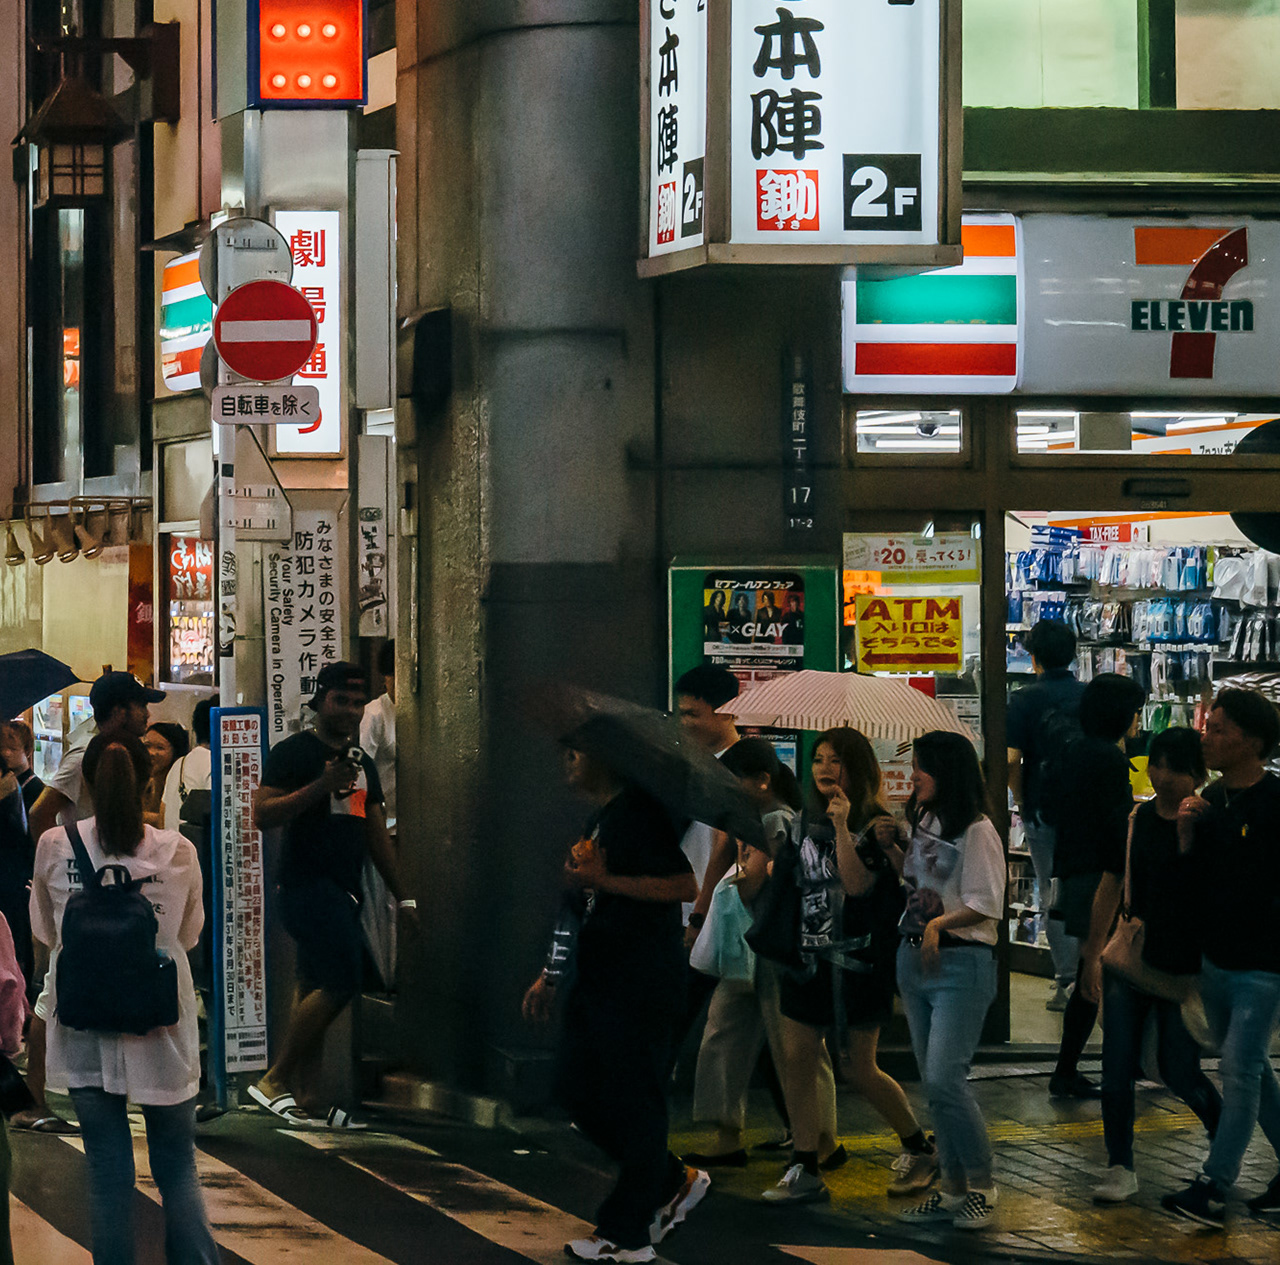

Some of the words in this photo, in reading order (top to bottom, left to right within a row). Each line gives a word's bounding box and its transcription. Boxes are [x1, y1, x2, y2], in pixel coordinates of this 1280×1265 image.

[683, 171, 703, 223] 2F
[850, 165, 919, 217] 2F
[219, 391, 312, 419] 自転車を除く
[791, 486, 811, 504] 17
[1089, 524, 1121, 542] TAX-FREE
[282, 556, 294, 584] Your
[880, 547, 906, 566] 20
[268, 553, 280, 603] Security
[282, 586, 294, 627] Safety
[859, 598, 961, 622] ATM
[270, 606, 282, 655] Camera
[870, 620, 950, 635] 入り口は
[271, 674, 285, 733] Operation
[222, 733, 259, 745] お知らせ
